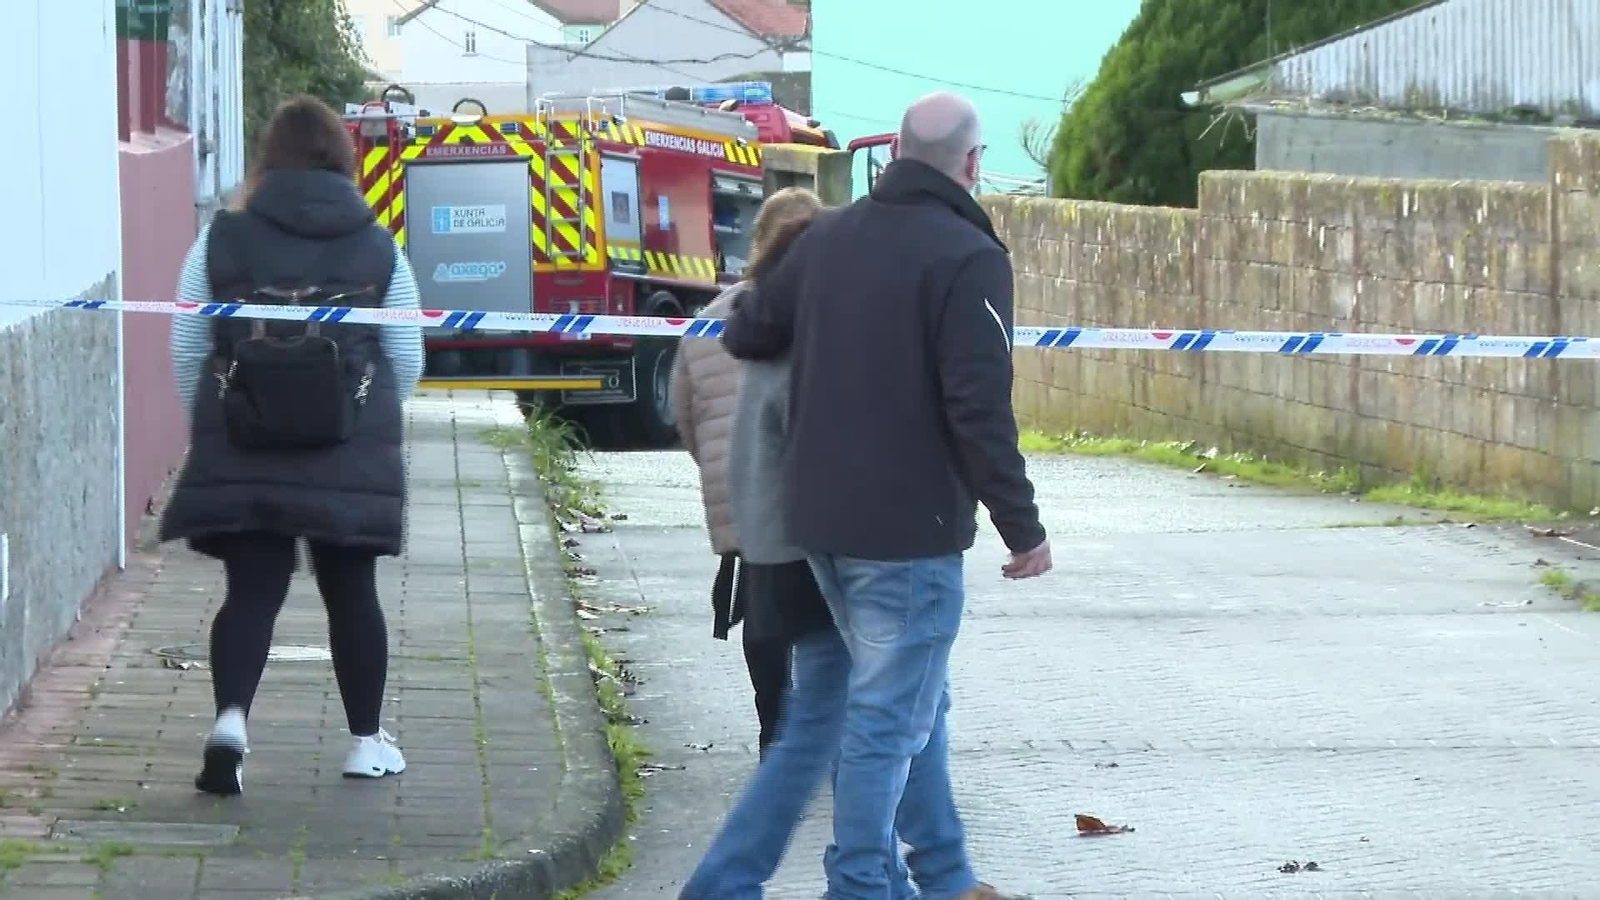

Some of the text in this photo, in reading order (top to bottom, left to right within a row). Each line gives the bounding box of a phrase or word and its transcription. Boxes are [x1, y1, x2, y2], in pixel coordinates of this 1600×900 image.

[644, 130, 725, 158] EMERXENCIAS GALICIA
[426, 145, 507, 156] EMERXENCIAS
[453, 208, 486, 218] XUNTA
[453, 217, 505, 228] DE GALICIA
